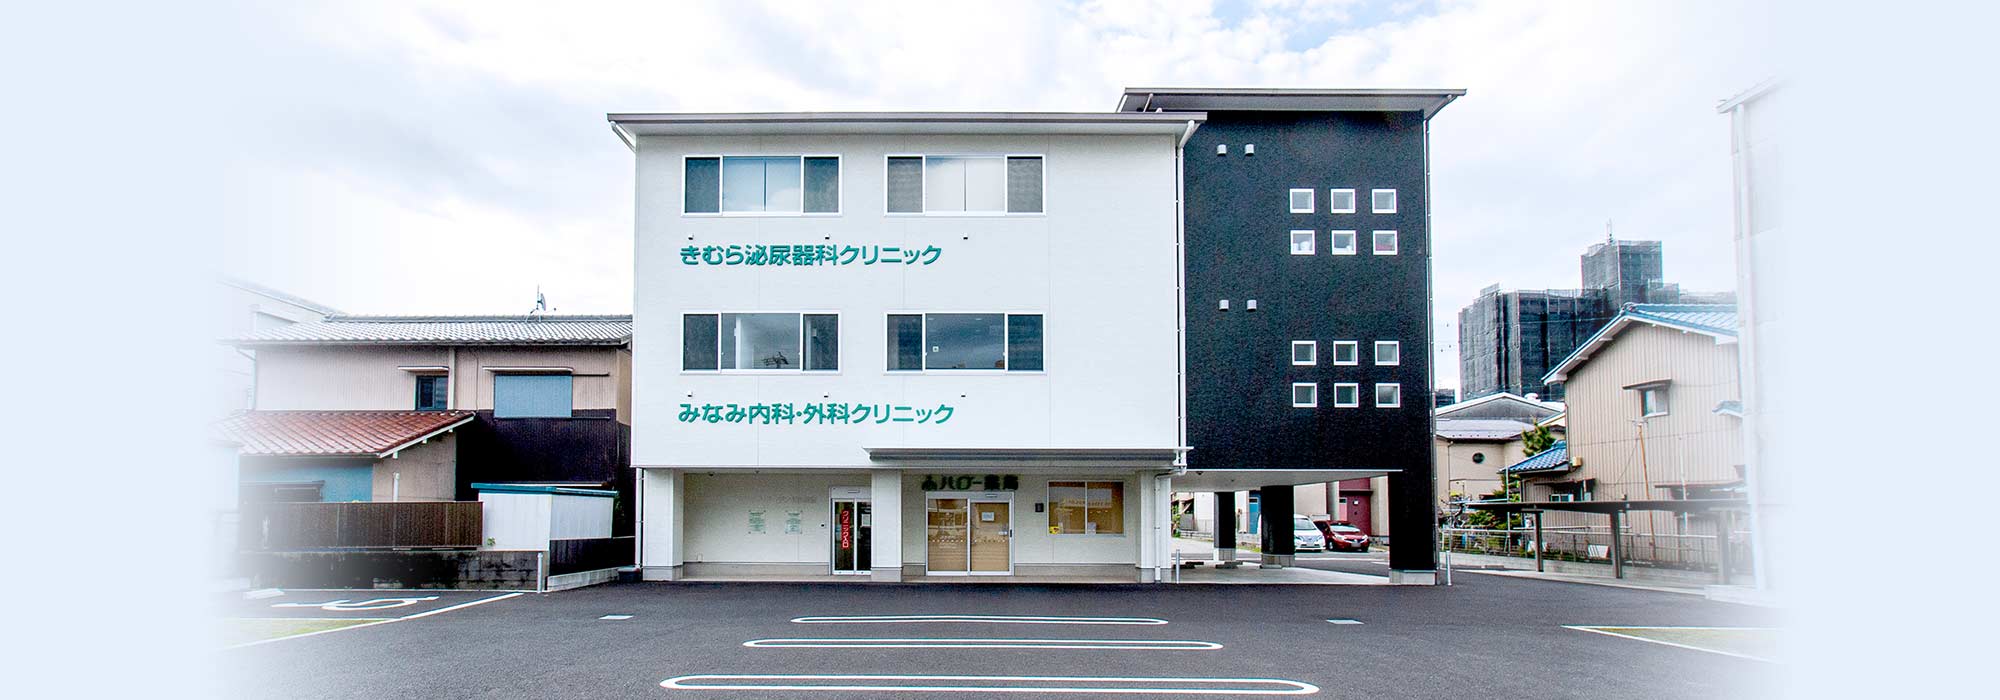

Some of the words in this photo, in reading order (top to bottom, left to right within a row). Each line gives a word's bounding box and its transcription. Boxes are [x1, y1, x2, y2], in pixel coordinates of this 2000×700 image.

[680, 244, 942, 266] きむら泌尿器科クリニック
[678, 402, 954, 424] みなみ内科・外科クリニック
